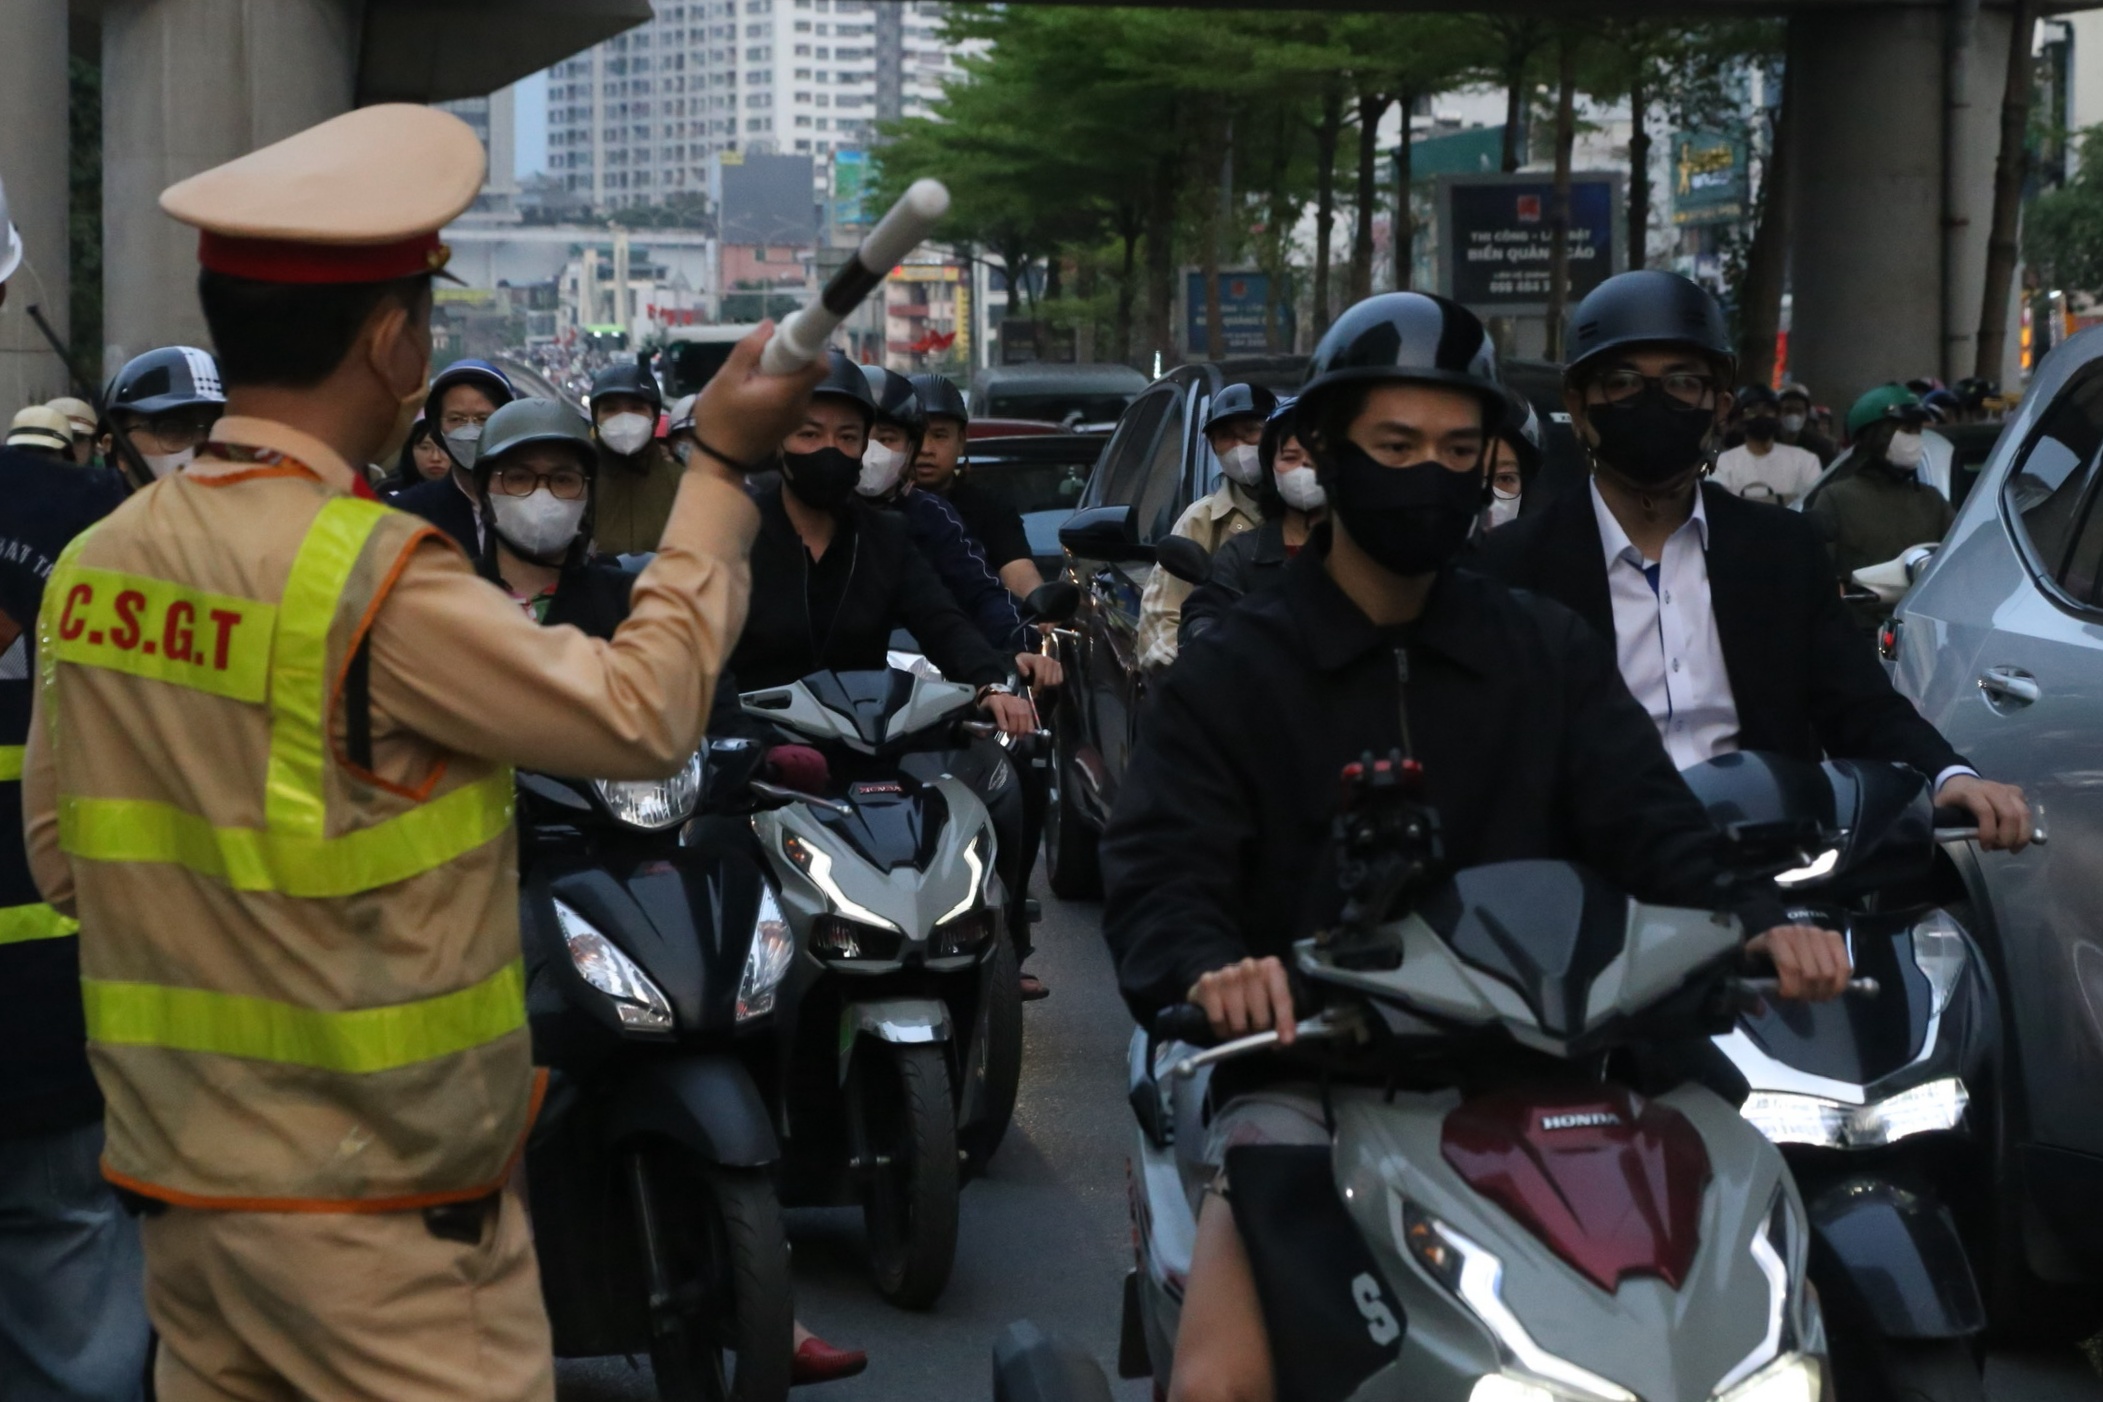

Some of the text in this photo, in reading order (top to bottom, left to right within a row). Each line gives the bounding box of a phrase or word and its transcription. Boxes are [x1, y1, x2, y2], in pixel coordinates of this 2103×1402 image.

[59, 583, 242, 671] C.S.G.T
[1542, 1112, 1622, 1130] HONDA
[1352, 1271, 1400, 1346] S
